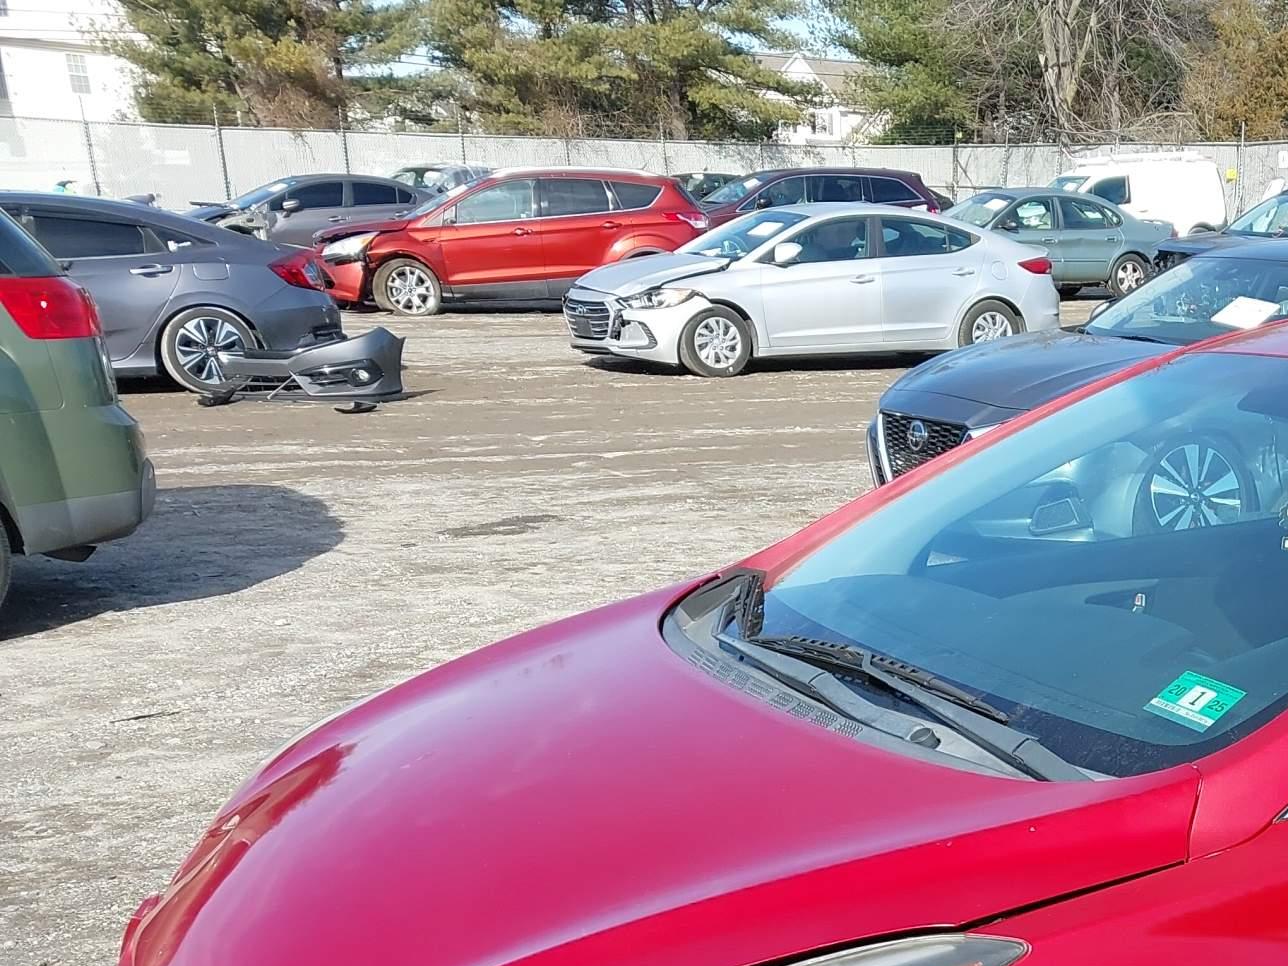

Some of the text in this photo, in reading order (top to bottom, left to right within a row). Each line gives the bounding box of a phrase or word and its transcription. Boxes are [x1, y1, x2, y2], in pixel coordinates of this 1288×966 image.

[1168, 684, 1188, 697] 20
[1189, 691, 1207, 706] 1
[1207, 700, 1228, 712] 25
